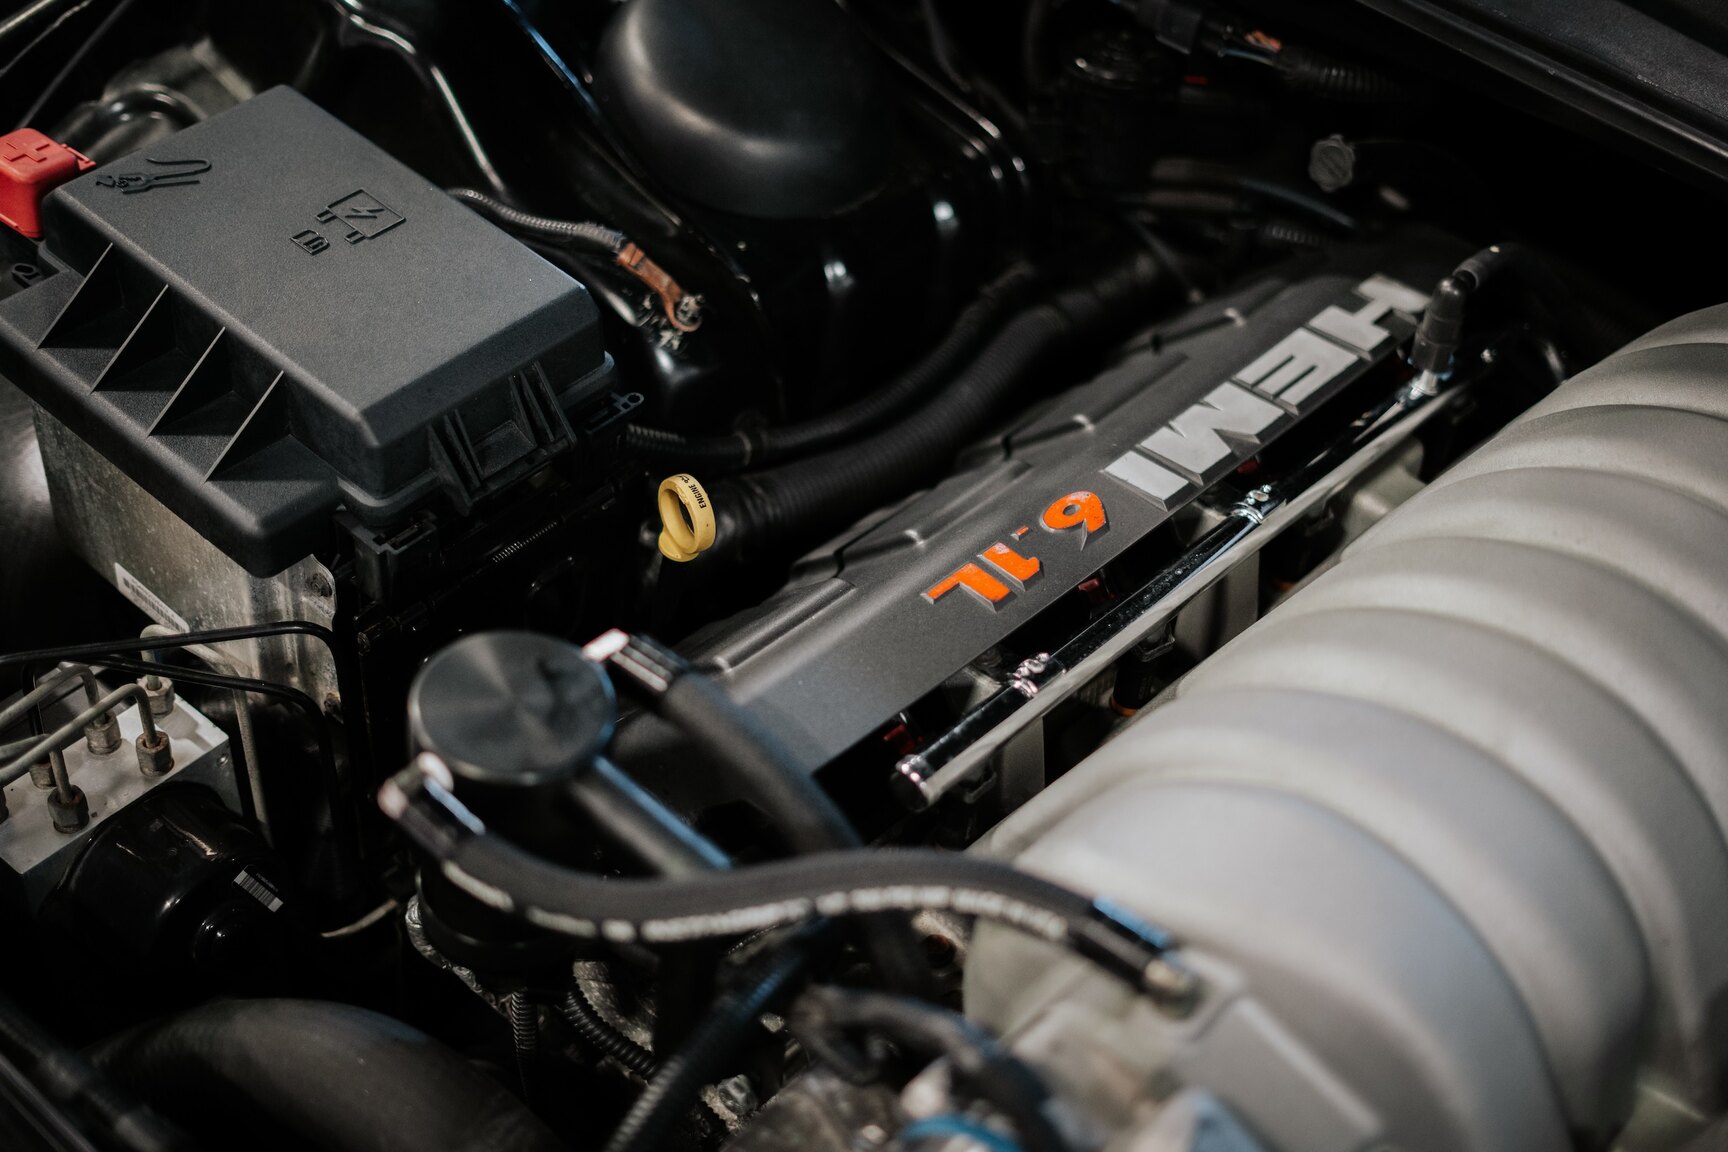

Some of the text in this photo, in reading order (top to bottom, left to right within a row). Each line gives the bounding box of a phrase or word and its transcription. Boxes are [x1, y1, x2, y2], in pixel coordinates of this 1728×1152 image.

[688, 484, 707, 509] ENGINE
[921, 274, 1432, 612] HEMI 6.1L
